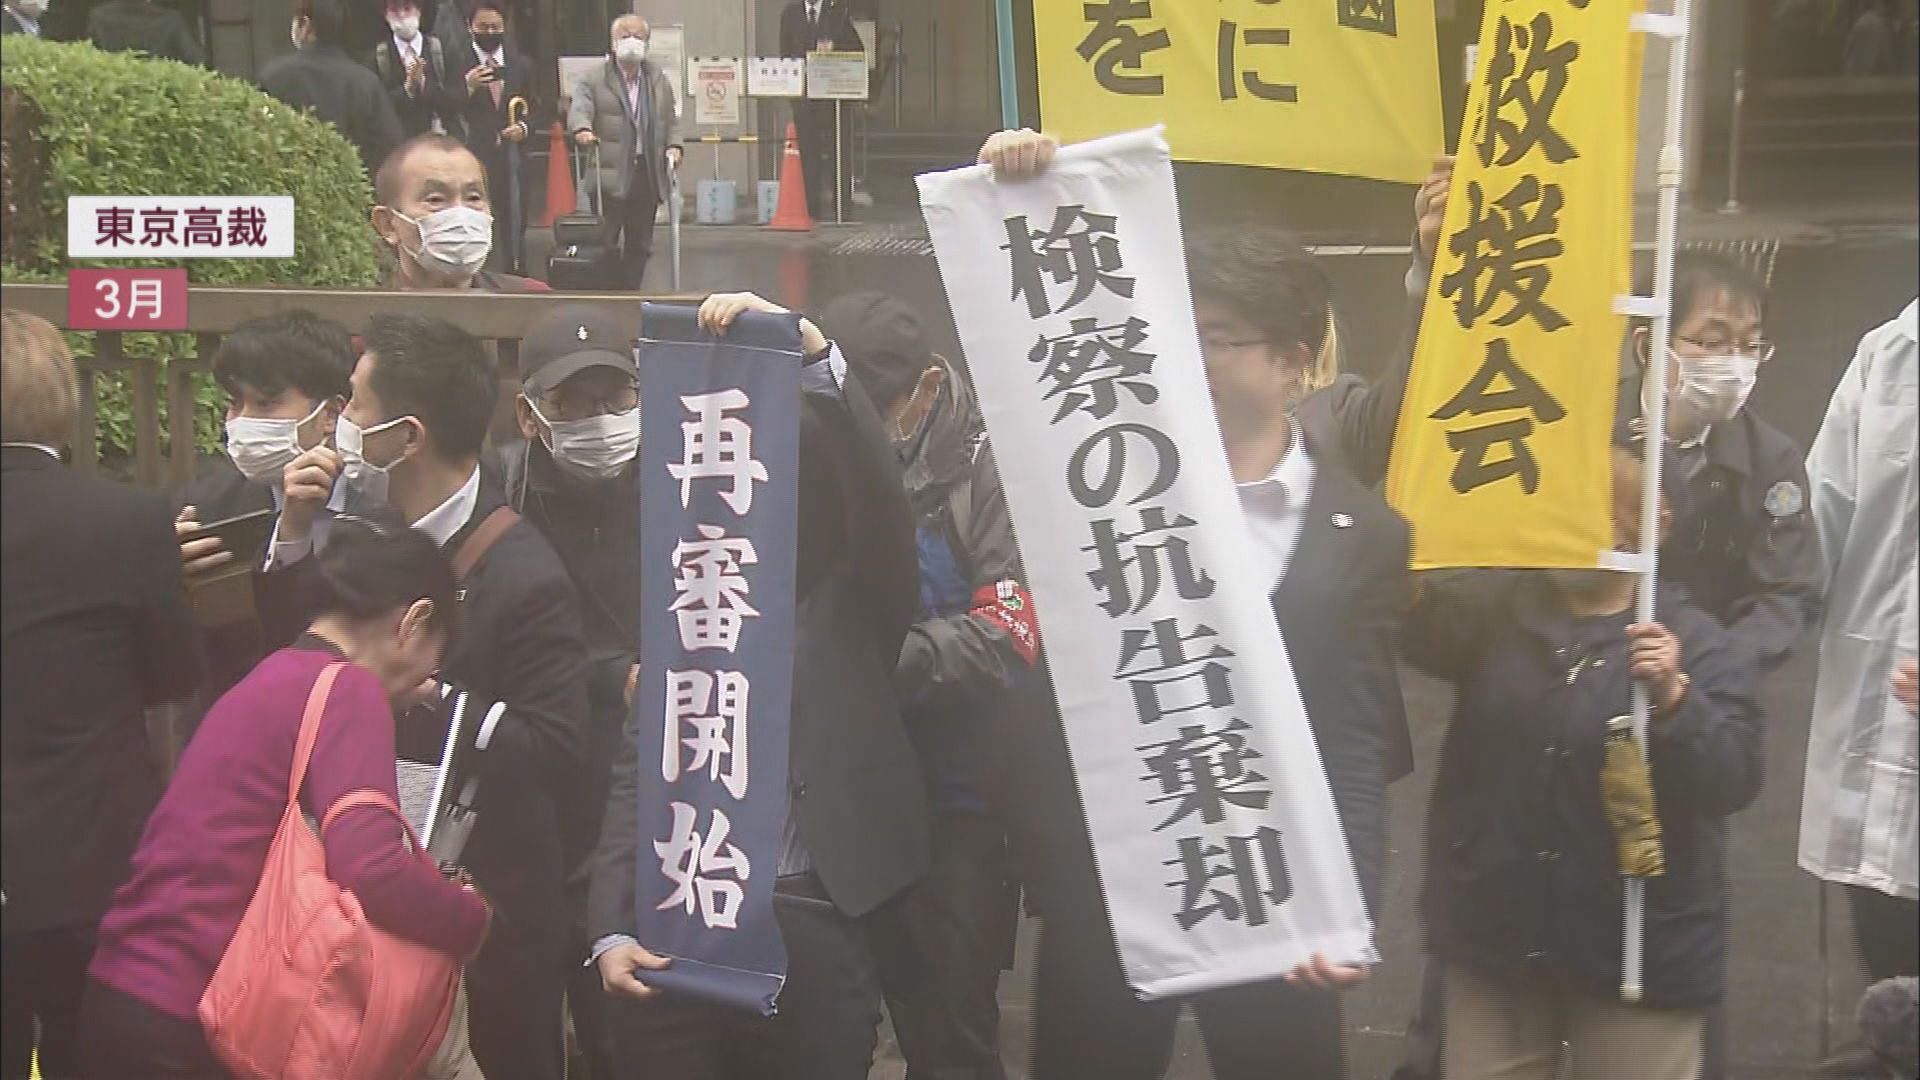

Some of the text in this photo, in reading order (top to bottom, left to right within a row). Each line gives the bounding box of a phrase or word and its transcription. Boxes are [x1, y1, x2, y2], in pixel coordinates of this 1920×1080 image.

[1217, 0, 1297, 103] に
[1428, 0, 1590, 495] 救援会
[653, 388, 769, 919] 再審開始
[1000, 204, 1294, 930] 検察の抗告棄却
